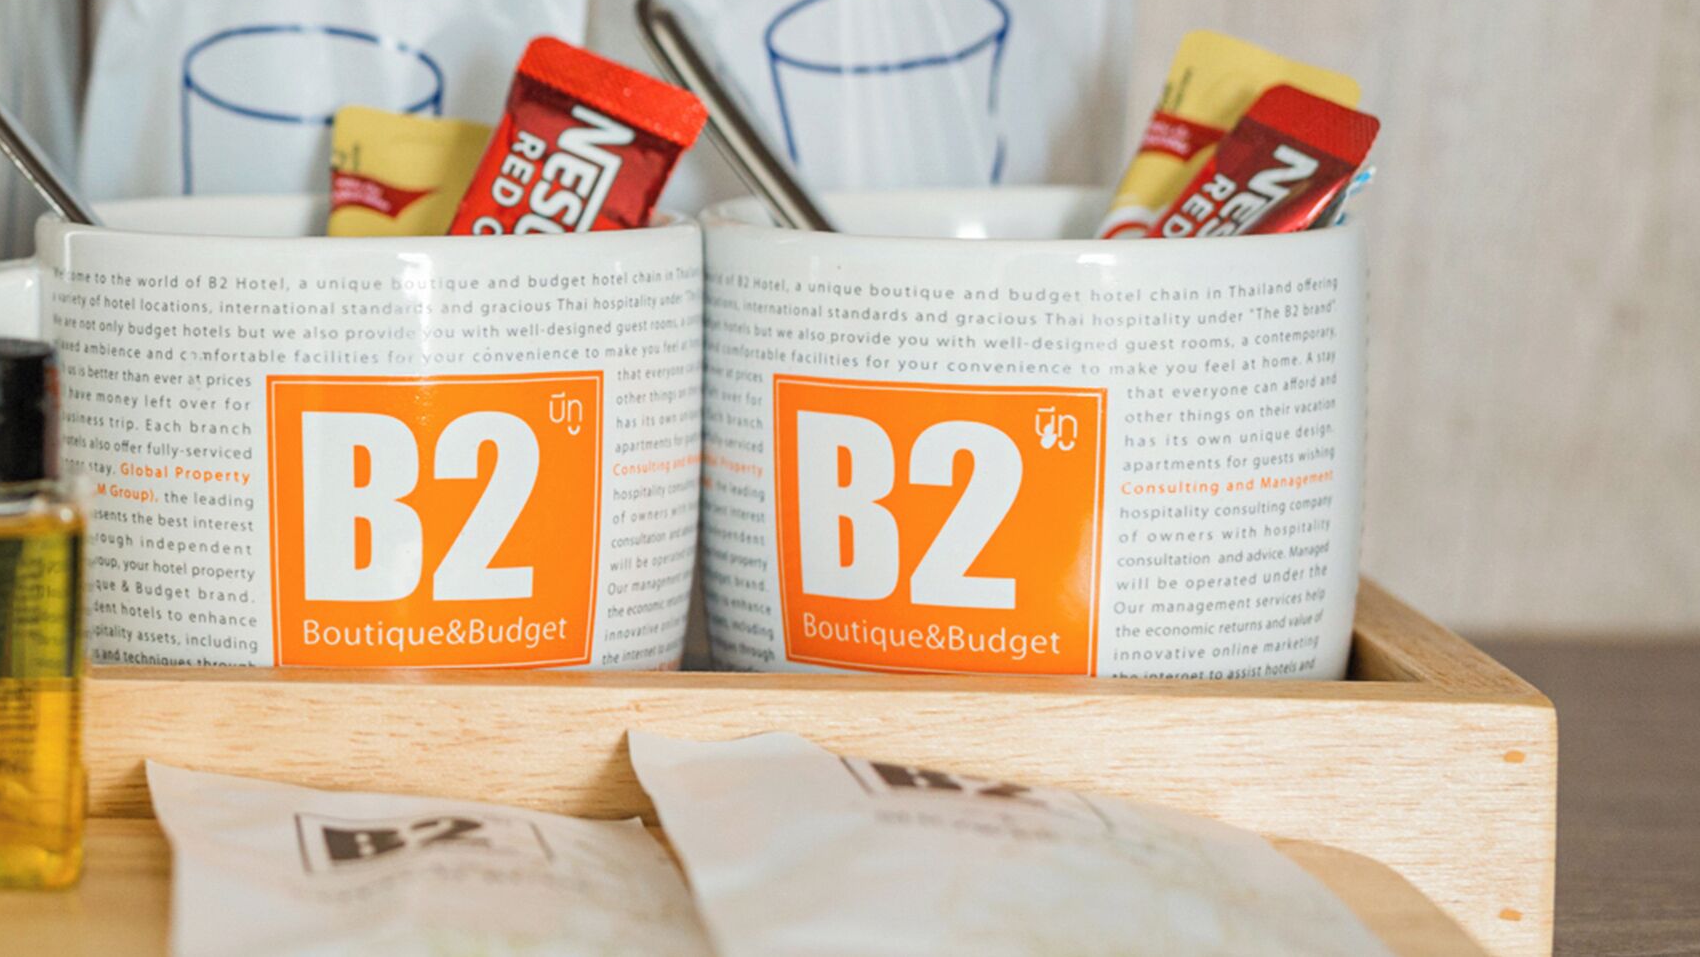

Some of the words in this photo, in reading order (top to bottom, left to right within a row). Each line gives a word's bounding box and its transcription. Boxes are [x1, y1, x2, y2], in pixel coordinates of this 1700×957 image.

[492, 131, 547, 208] RED
[1162, 173, 1237, 238] RED
[111, 274, 131, 286] the
[138, 276, 178, 288] world
[185, 275, 201, 288] of
[316, 278, 382, 292] unique
[391, 276, 479, 290] boutique
[488, 276, 520, 289] and
[528, 274, 585, 290] budget
[592, 272, 628, 286] hotel
[632, 272, 661, 284] chain
[808, 283, 862, 296] unique
[870, 284, 954, 301] boutique
[964, 288, 998, 300] and
[1009, 288, 1080, 304] budget
[1090, 289, 1140, 302] hotel
[1150, 288, 1199, 301] chain
[1228, 281, 1292, 298] Thailand
[104, 296, 135, 310] hotel
[220, 302, 334, 314] international
[342, 300, 434, 315] standards
[441, 300, 473, 314] and
[480, 300, 551, 317] gracious
[557, 298, 587, 310] Thai
[593, 295, 656, 311] hospitality
[828, 308, 908, 322] standards
[915, 310, 948, 323] and
[956, 313, 1036, 327] gracious
[1045, 312, 1084, 326] Thai
[1092, 312, 1190, 329] hospitality
[1198, 310, 1242, 324] under
[99, 320, 124, 336] only
[128, 322, 176, 339] budget
[183, 324, 230, 338] hotels
[238, 326, 264, 338] but
[272, 329, 296, 339] we
[303, 326, 338, 340] also
[345, 326, 415, 342] provide
[462, 325, 499, 338] with
[506, 321, 611, 338] well-designed
[616, 320, 647, 336] guest
[798, 328, 825, 342] also
[830, 332, 891, 345] provide
[898, 336, 928, 348] you
[936, 336, 976, 348] with
[1126, 338, 1174, 354] guest
[84, 343, 140, 358] ambience
[146, 348, 173, 360] and
[294, 350, 378, 364] facilities
[388, 350, 414, 363] for
[473, 347, 579, 363] convenience
[605, 344, 638, 357] make
[791, 350, 858, 367] facilities
[866, 355, 889, 368] for
[898, 360, 938, 372] your
[946, 361, 1071, 374] convenience
[1110, 362, 1158, 375] make
[1166, 364, 1197, 376] you
[1205, 359, 1234, 373] feel
[88, 366, 118, 380] better
[122, 370, 150, 382] than
[154, 374, 182, 384] ever
[206, 374, 252, 388] prices
[1127, 386, 1163, 399] that
[1172, 386, 1248, 400] everyone
[1254, 382, 1277, 394] can
[96, 392, 138, 408] money
[145, 395, 171, 408] left
[179, 399, 216, 410] over
[225, 397, 250, 411] for
[1125, 410, 1172, 423] other
[1180, 409, 1230, 424] things
[1260, 404, 1290, 418] their
[146, 418, 181, 432] Each
[190, 420, 251, 435] branch
[114, 440, 142, 454] offer
[1125, 435, 1156, 447] has
[1166, 436, 1188, 446] its
[1197, 435, 1231, 446] own
[1240, 430, 1290, 444] unique
[120, 462, 168, 478] Global
[175, 466, 250, 485] Property
[1122, 458, 1220, 474] apartments
[1226, 455, 1247, 468] for
[1252, 453, 1294, 470] guests
[1121, 482, 1219, 496] Consulting
[1226, 479, 1254, 492] and
[164, 491, 188, 504] the
[194, 492, 254, 511] leading
[301, 410, 540, 602] B2
[797, 409, 1023, 610] B2
[1120, 506, 1209, 521] hospitality
[1214, 502, 1286, 517] consulting
[132, 512, 153, 525] the
[158, 514, 188, 528] best
[194, 516, 253, 532] interest
[1147, 531, 1213, 542] owners
[1222, 526, 1256, 540] with
[140, 536, 251, 555] independent
[1117, 553, 1210, 567] consultation
[1218, 550, 1243, 564] and
[123, 560, 149, 572] your
[153, 560, 187, 575] hotel
[192, 566, 255, 582] property
[1116, 578, 1149, 590] will
[1185, 573, 1257, 591] operated
[1263, 568, 1304, 584] under
[136, 581, 189, 600] Budget
[121, 602, 162, 620] hotels
[188, 611, 257, 627] enhance
[1113, 602, 1144, 614] Our
[1151, 598, 1250, 616] management
[303, 616, 568, 652] Boutique&Budget
[803, 612, 1061, 661] Boutique&Budget
[1116, 625, 1140, 638] the
[1145, 623, 1214, 637] economic
[186, 634, 258, 654] including
[1114, 647, 1205, 660] innovative
[1212, 644, 1258, 658] online
